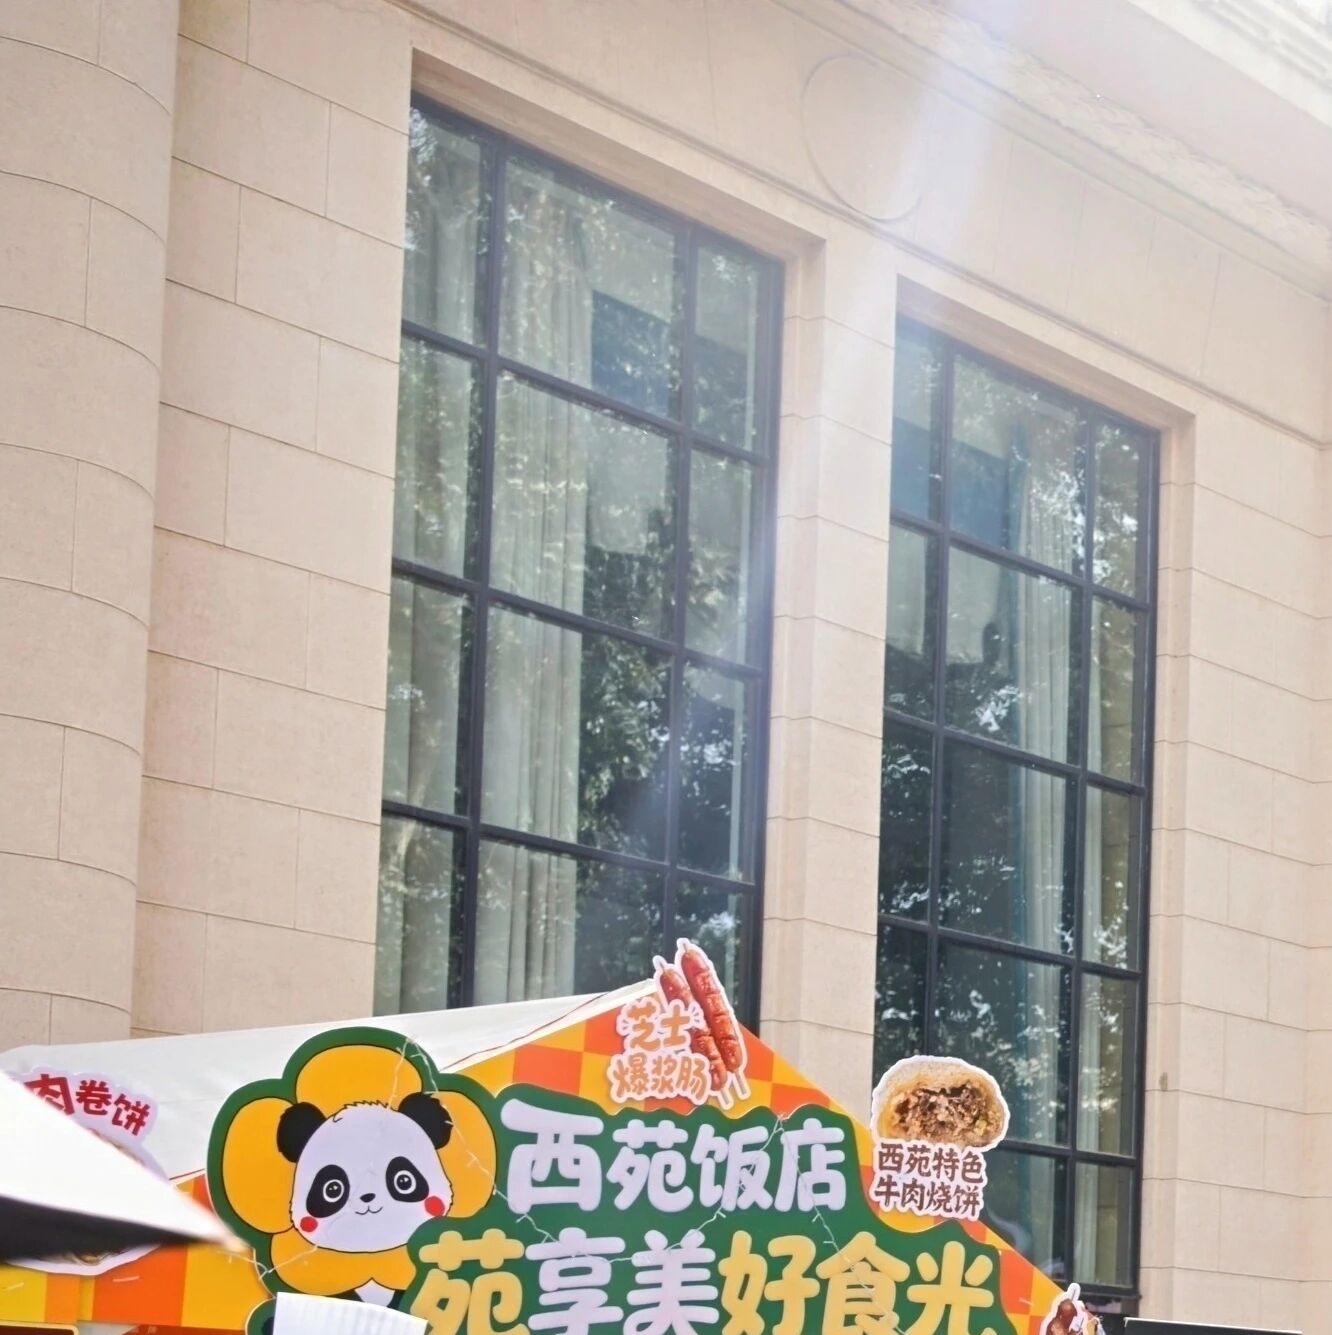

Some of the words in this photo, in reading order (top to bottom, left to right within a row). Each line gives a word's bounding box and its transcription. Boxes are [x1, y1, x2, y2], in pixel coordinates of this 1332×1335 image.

[627, 1003, 692, 1050] 芝士
[613, 1053, 708, 1102] 爆浆肠
[502, 1098, 847, 1213] 西苑饭店
[877, 1143, 984, 1182] 西苑特色
[875, 1179, 981, 1217] 牛肉烧饼
